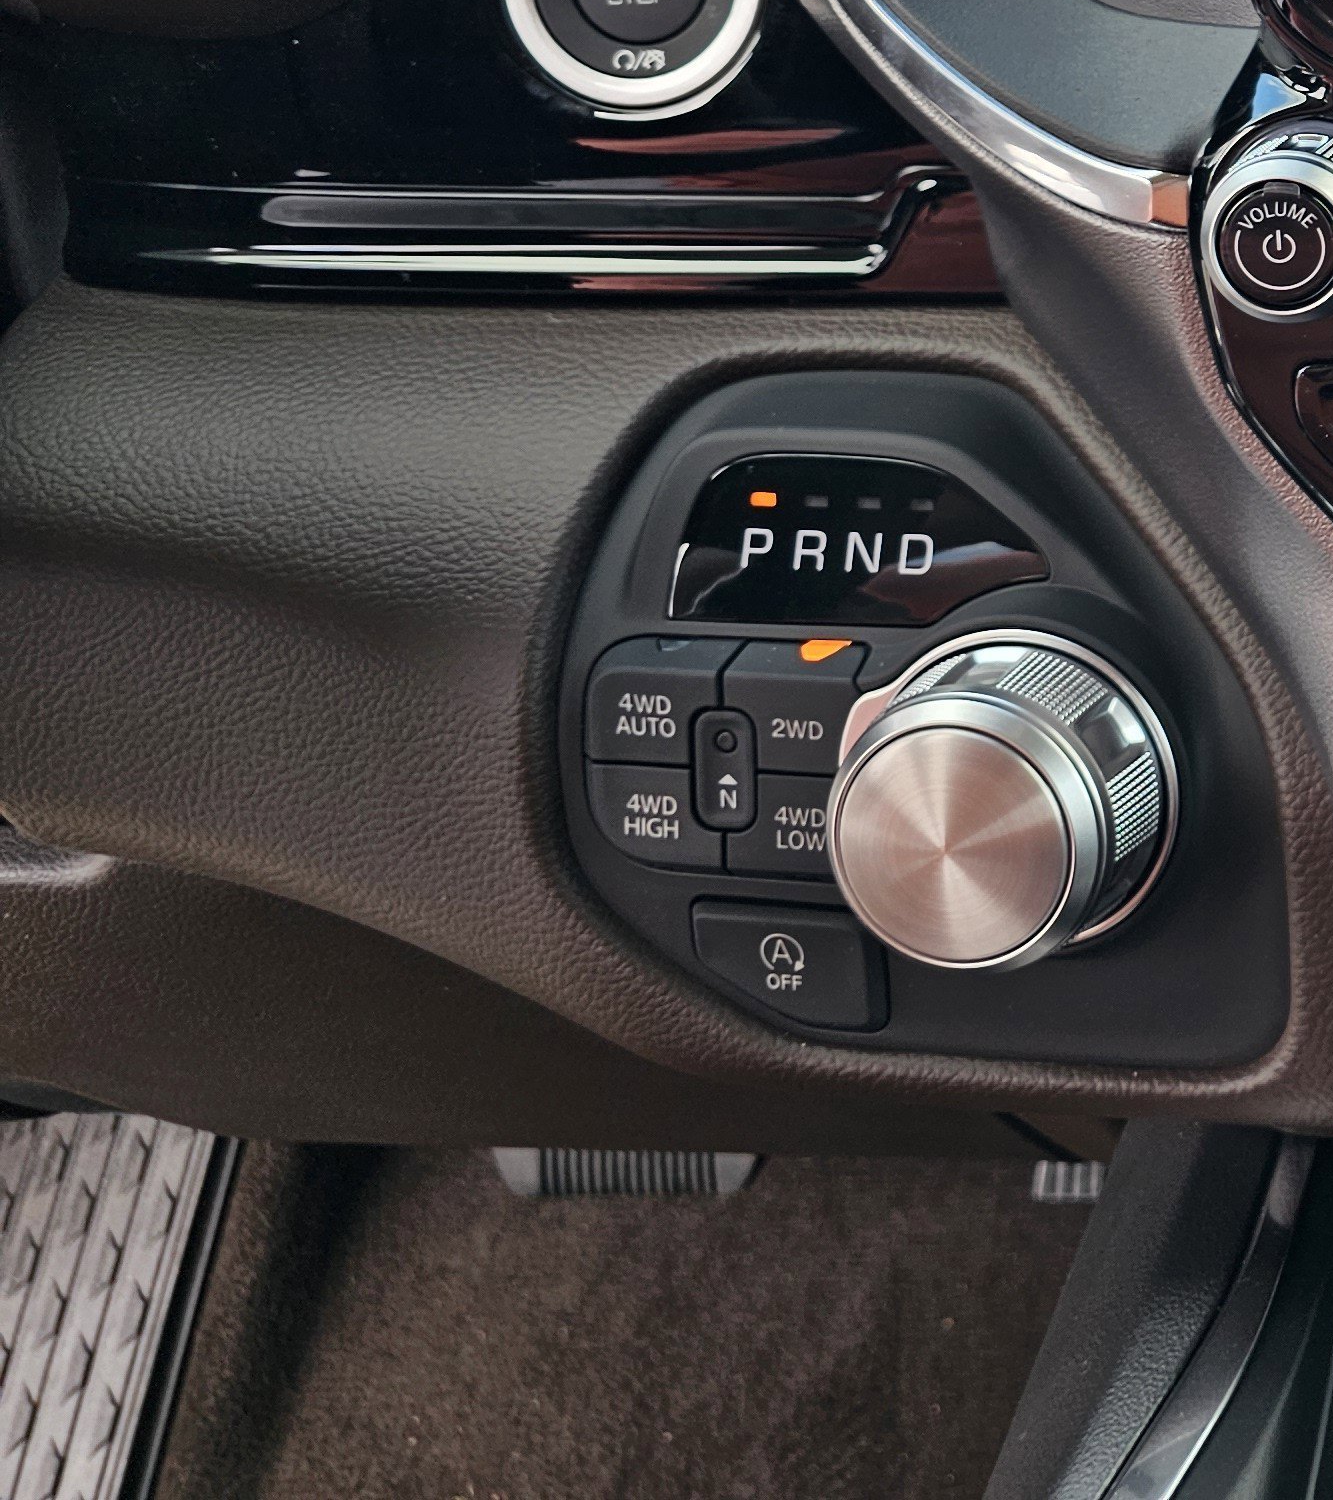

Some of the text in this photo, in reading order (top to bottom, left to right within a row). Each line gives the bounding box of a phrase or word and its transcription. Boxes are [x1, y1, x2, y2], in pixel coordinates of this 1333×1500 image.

[1237, 201, 1319, 229] VOLUME
[740, 527, 935, 576] P R N D
[617, 693, 672, 715] 4WD
[615, 716, 677, 739] AUTO
[770, 719, 824, 740] 2WD
[626, 794, 678, 815] 4WD
[719, 789, 737, 809] N
[774, 806, 826, 828] 4WD
[623, 817, 680, 840] HIGH
[776, 829, 828, 852] LOW
[766, 974, 803, 992] OFF
